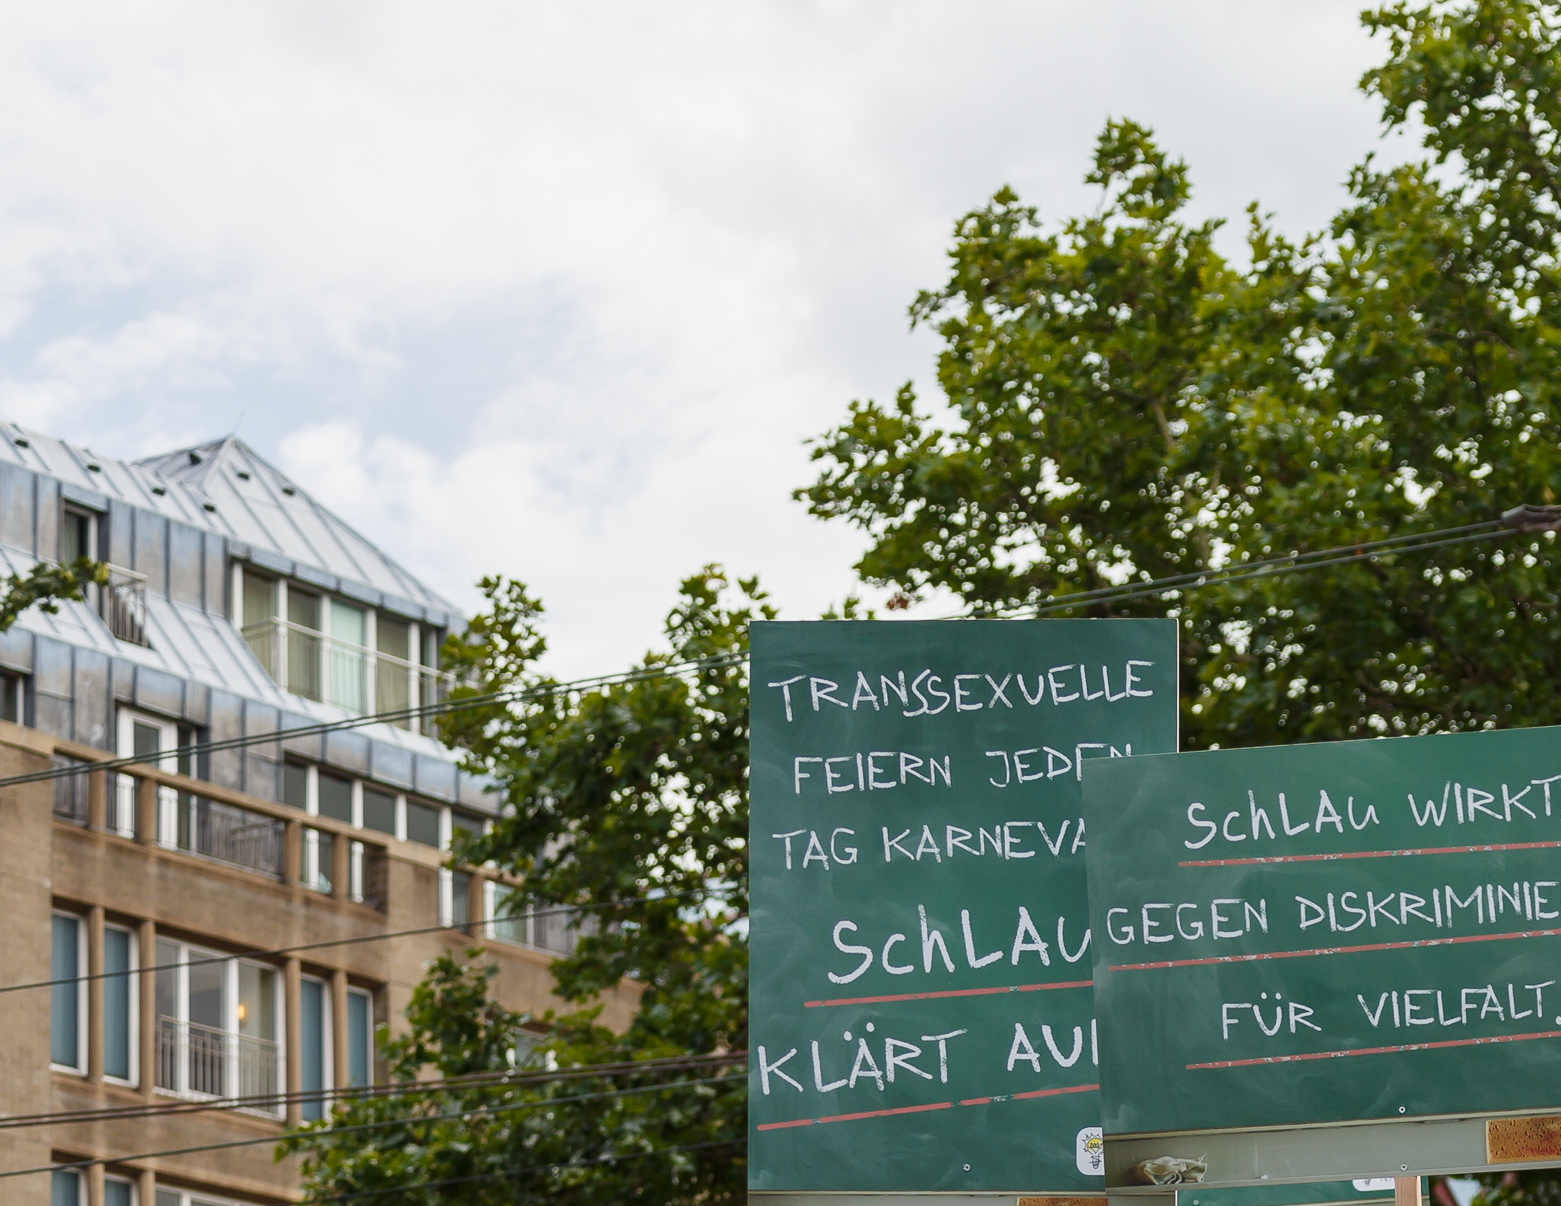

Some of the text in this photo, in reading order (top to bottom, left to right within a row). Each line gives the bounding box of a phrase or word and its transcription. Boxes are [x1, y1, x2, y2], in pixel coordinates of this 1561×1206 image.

[767, 659, 1155, 723] TRANSSEXUELLE
[794, 751, 952, 796] FEIERN
[1183, 789, 1380, 850] SchLAu
[771, 827, 858, 871] TAG
[1106, 898, 1269, 945] GEGEN
[1221, 991, 1323, 1041] FÜR
[757, 1021, 967, 1096] KLÄRT
